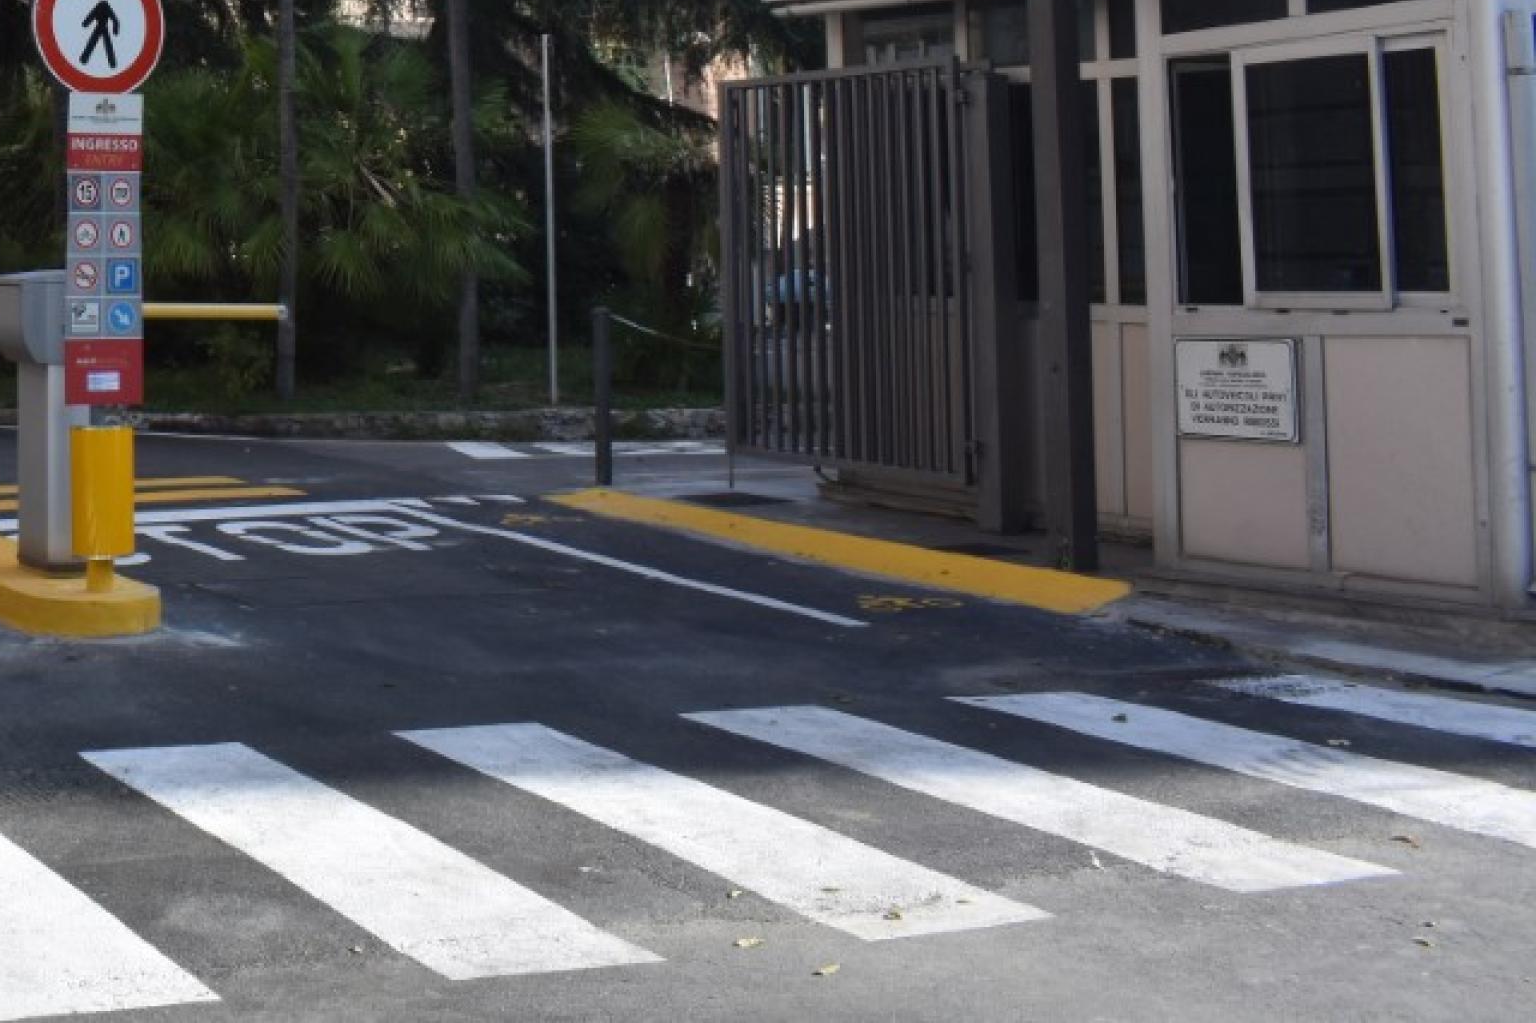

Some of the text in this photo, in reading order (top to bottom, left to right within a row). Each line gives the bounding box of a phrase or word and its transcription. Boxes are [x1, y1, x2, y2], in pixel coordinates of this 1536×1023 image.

[71, 137, 138, 153] INGRESSO
[80, 184, 93, 201] 15
[114, 266, 129, 287] P
